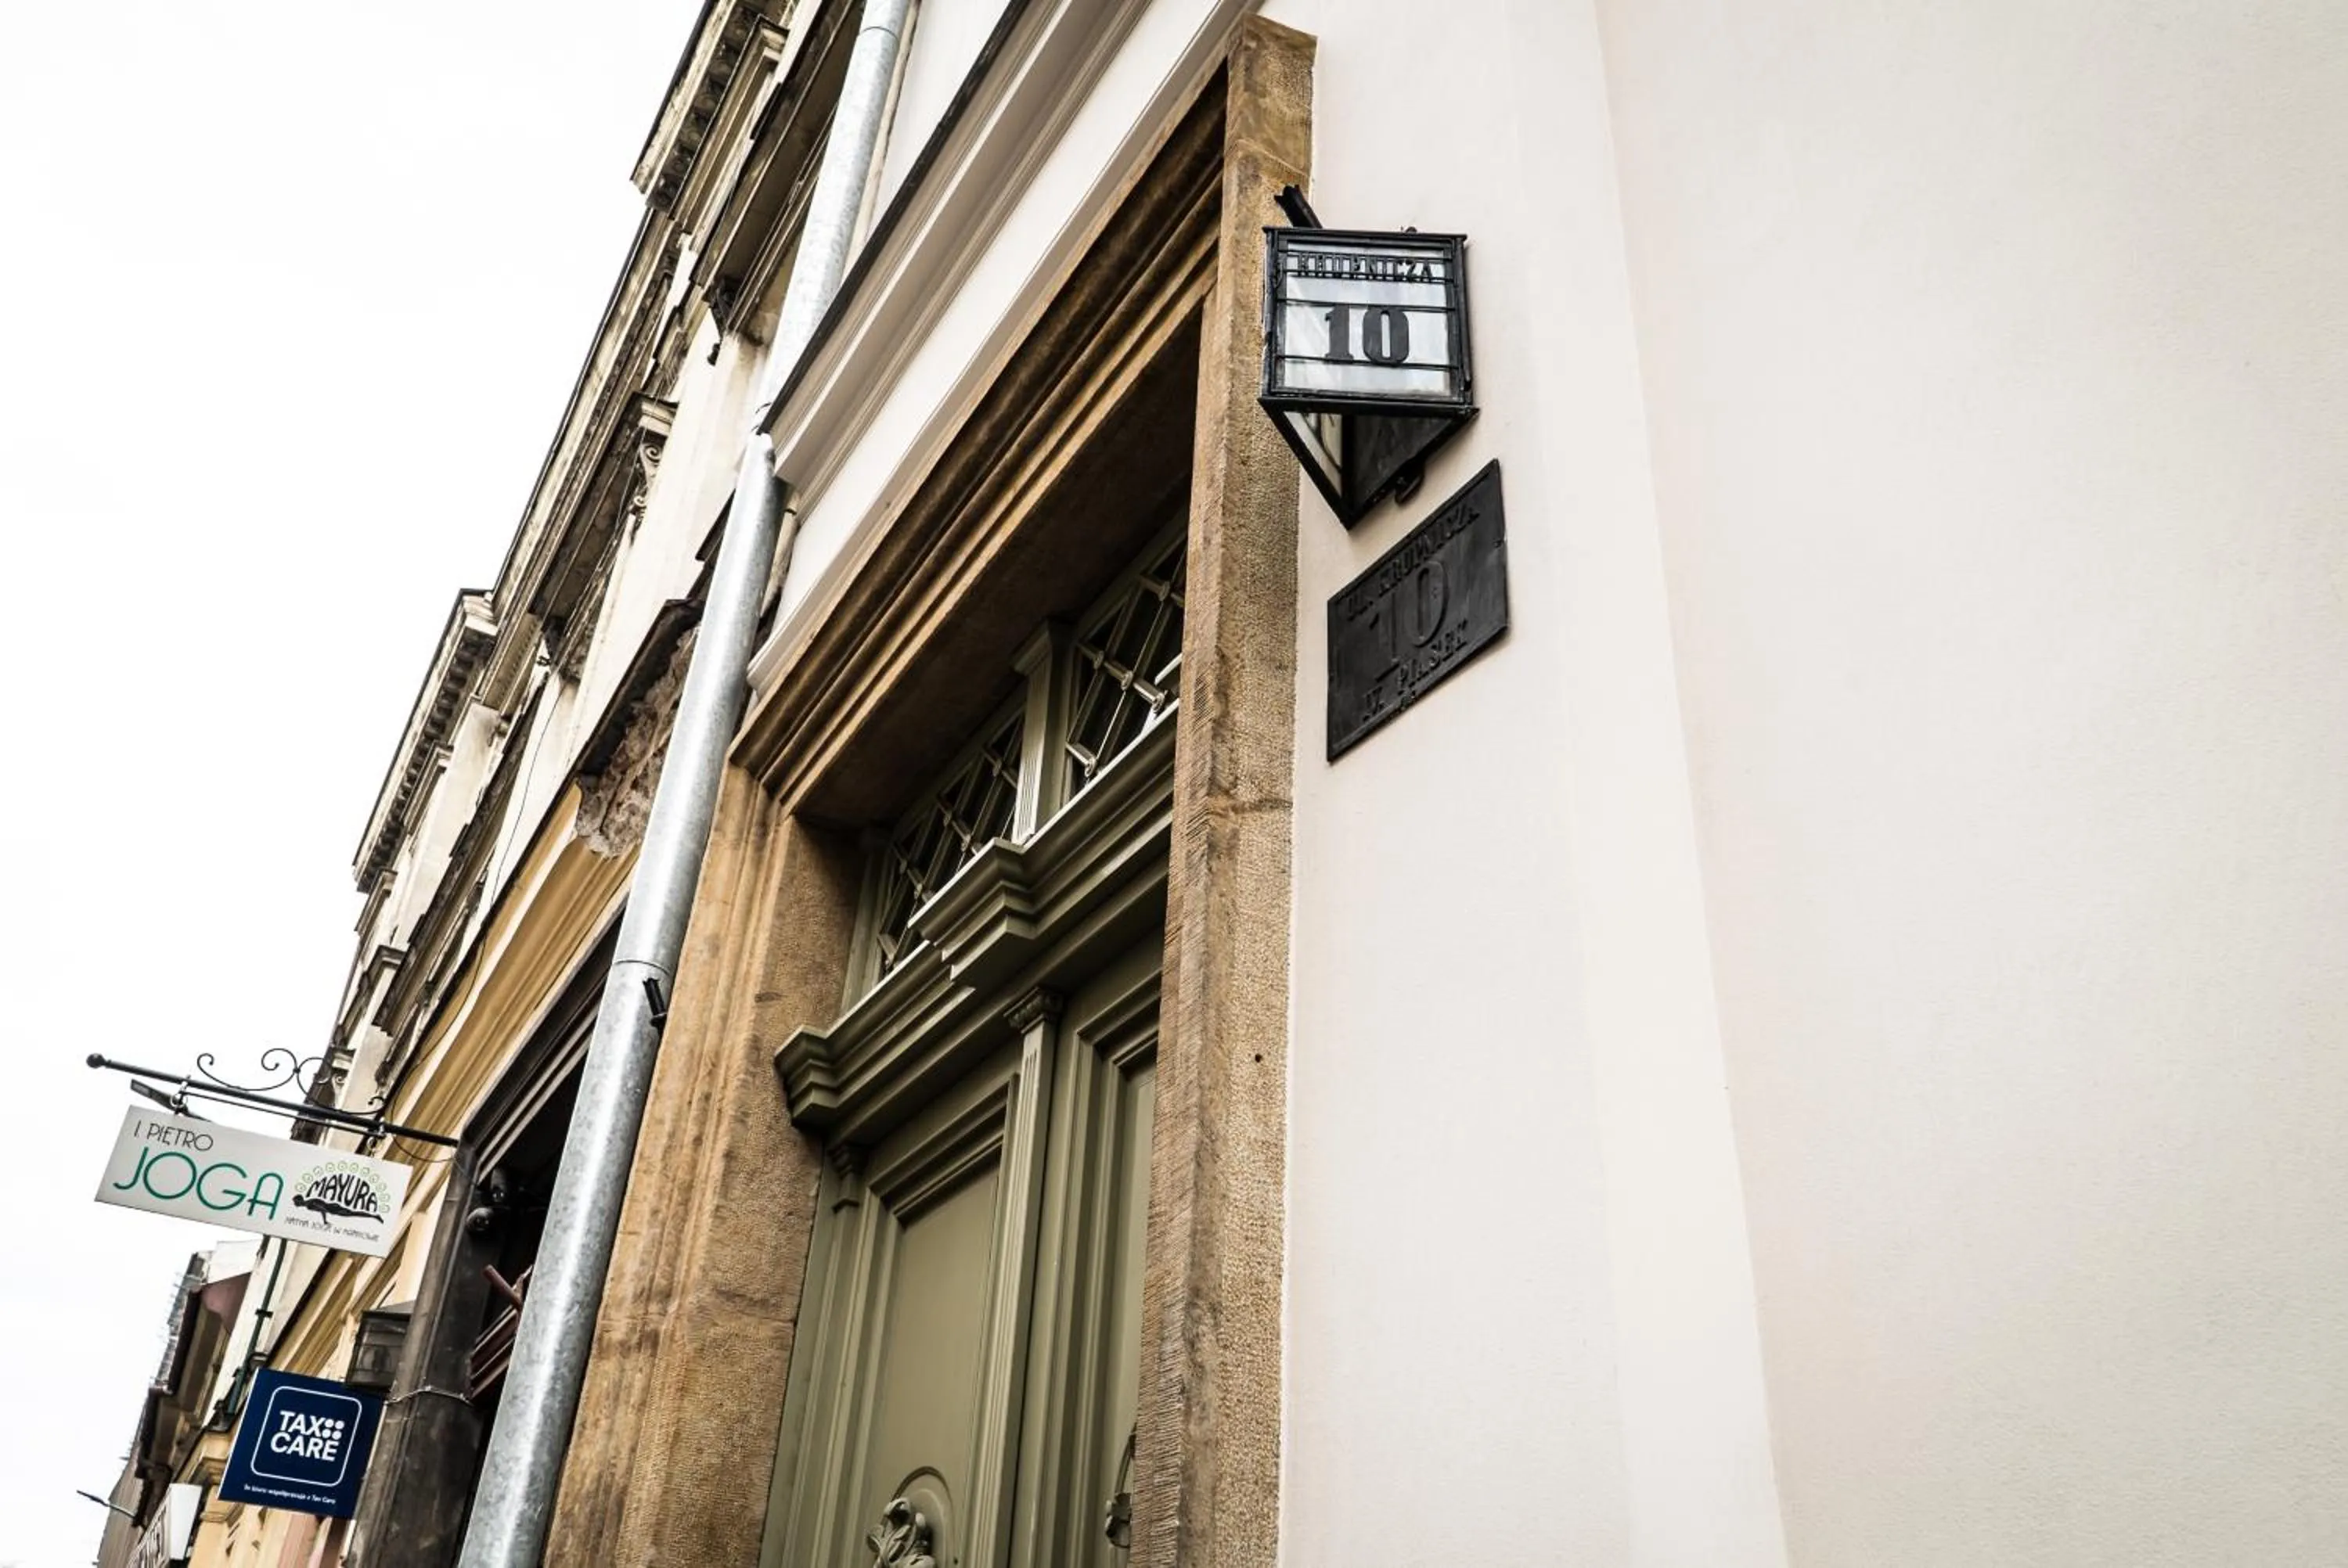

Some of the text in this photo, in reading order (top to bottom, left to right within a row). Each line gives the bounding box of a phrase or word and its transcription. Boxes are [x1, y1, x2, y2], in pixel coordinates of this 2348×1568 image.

[1325, 304, 1410, 365] 10
[1369, 559, 1449, 683] 10
[146, 1123, 214, 1152] PIĘTRO
[113, 1146, 284, 1221] JOGA
[305, 1174, 377, 1212] MAYURA
[279, 1410, 326, 1437] TAX
[270, 1431, 340, 1462] CARE
